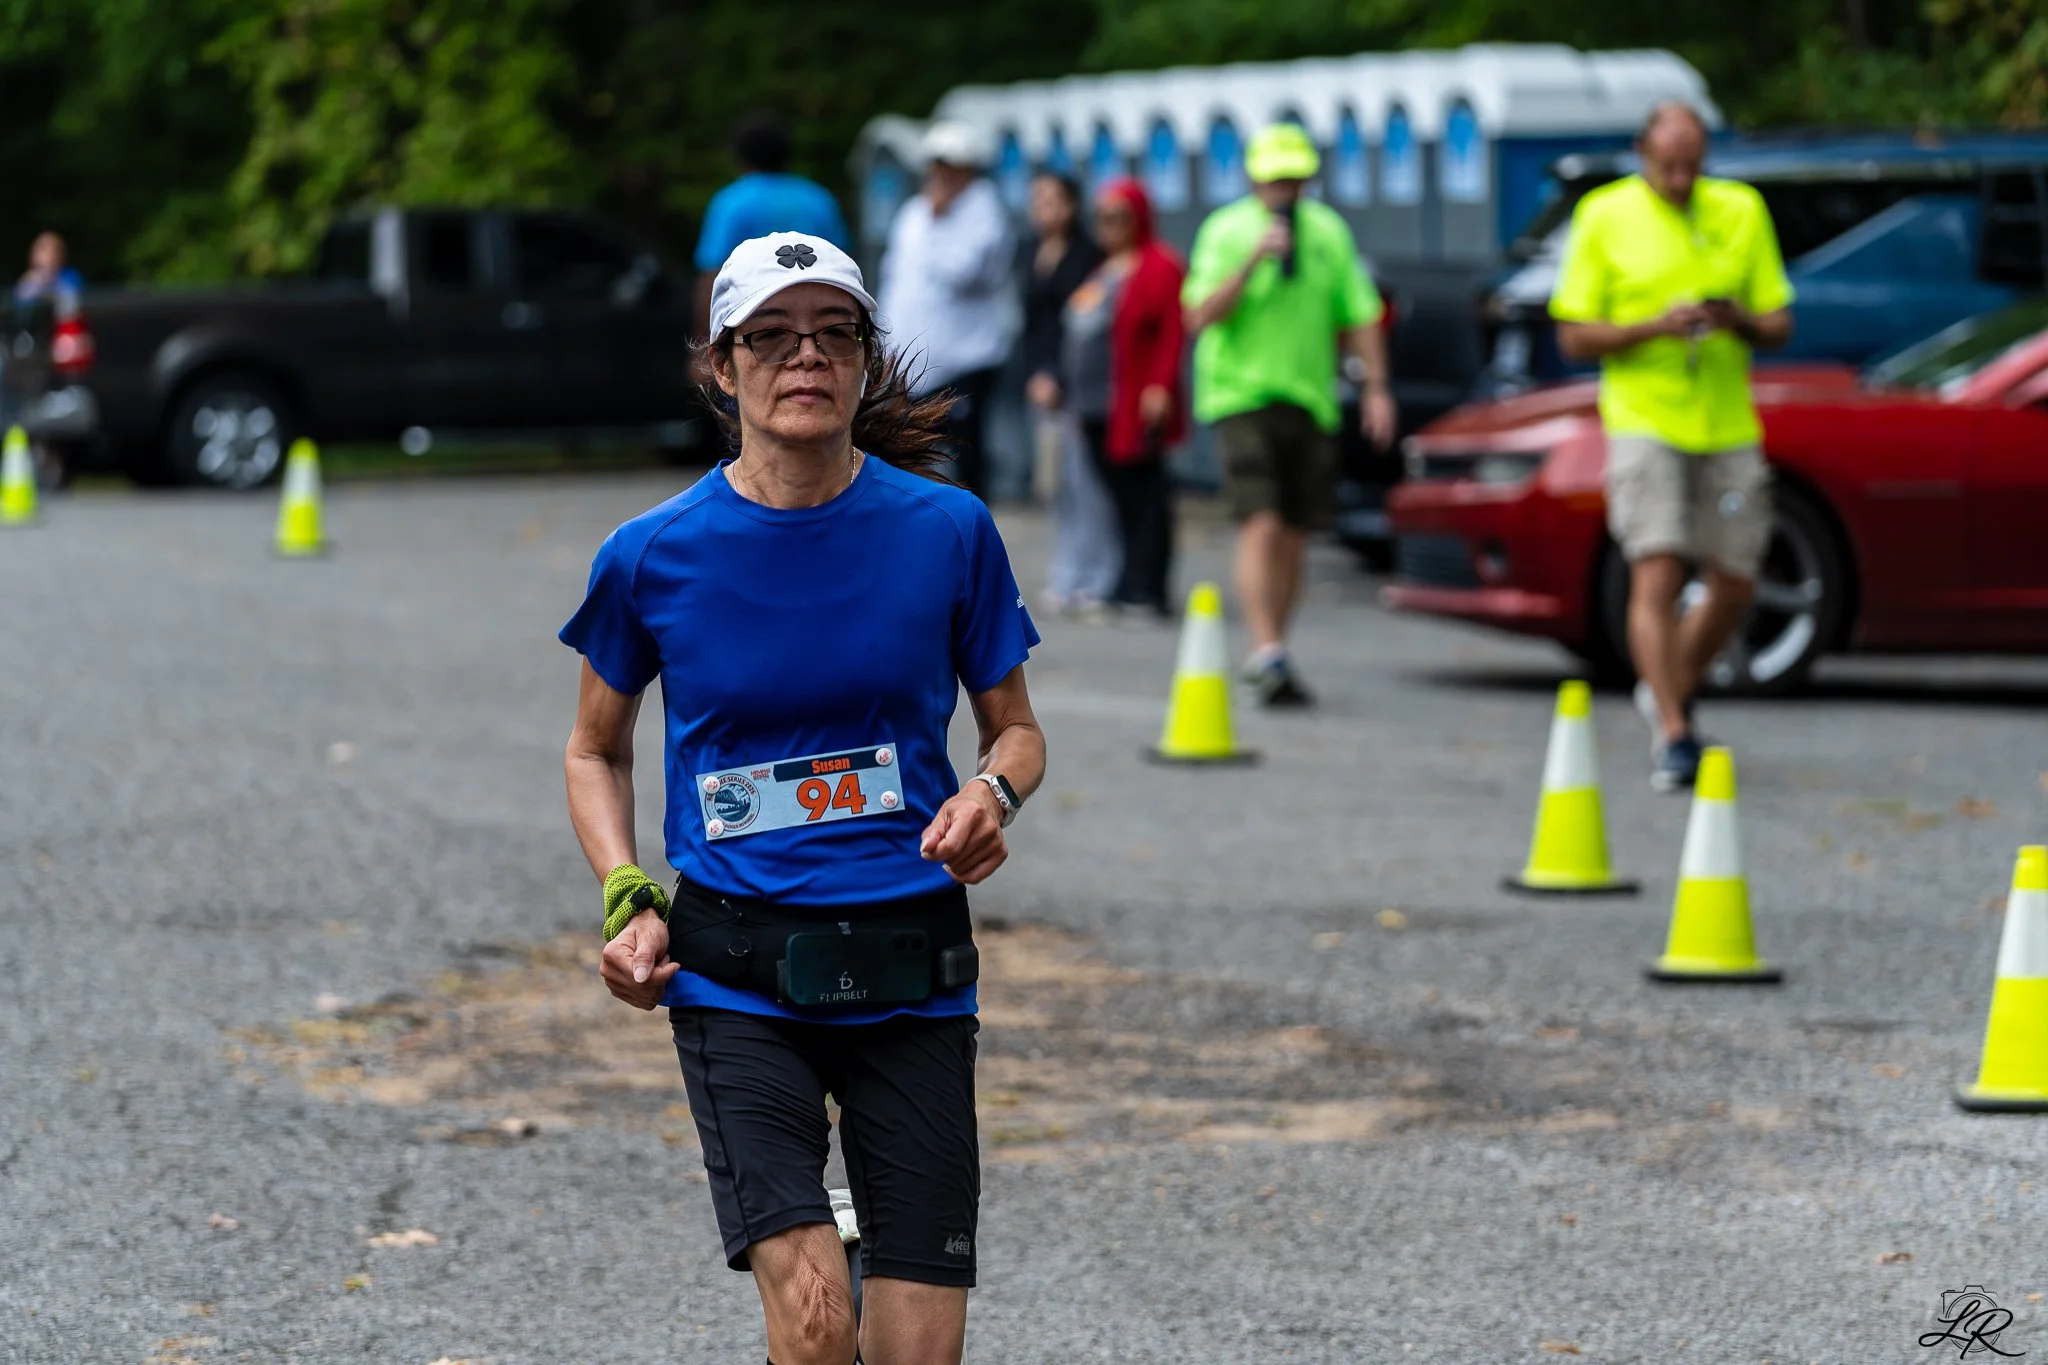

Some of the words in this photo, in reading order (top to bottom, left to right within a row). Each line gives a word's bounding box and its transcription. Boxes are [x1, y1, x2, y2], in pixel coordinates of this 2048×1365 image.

[811, 757, 851, 775] Susan
[727, 776, 745, 784] SERIES
[796, 773, 868, 822] 94
